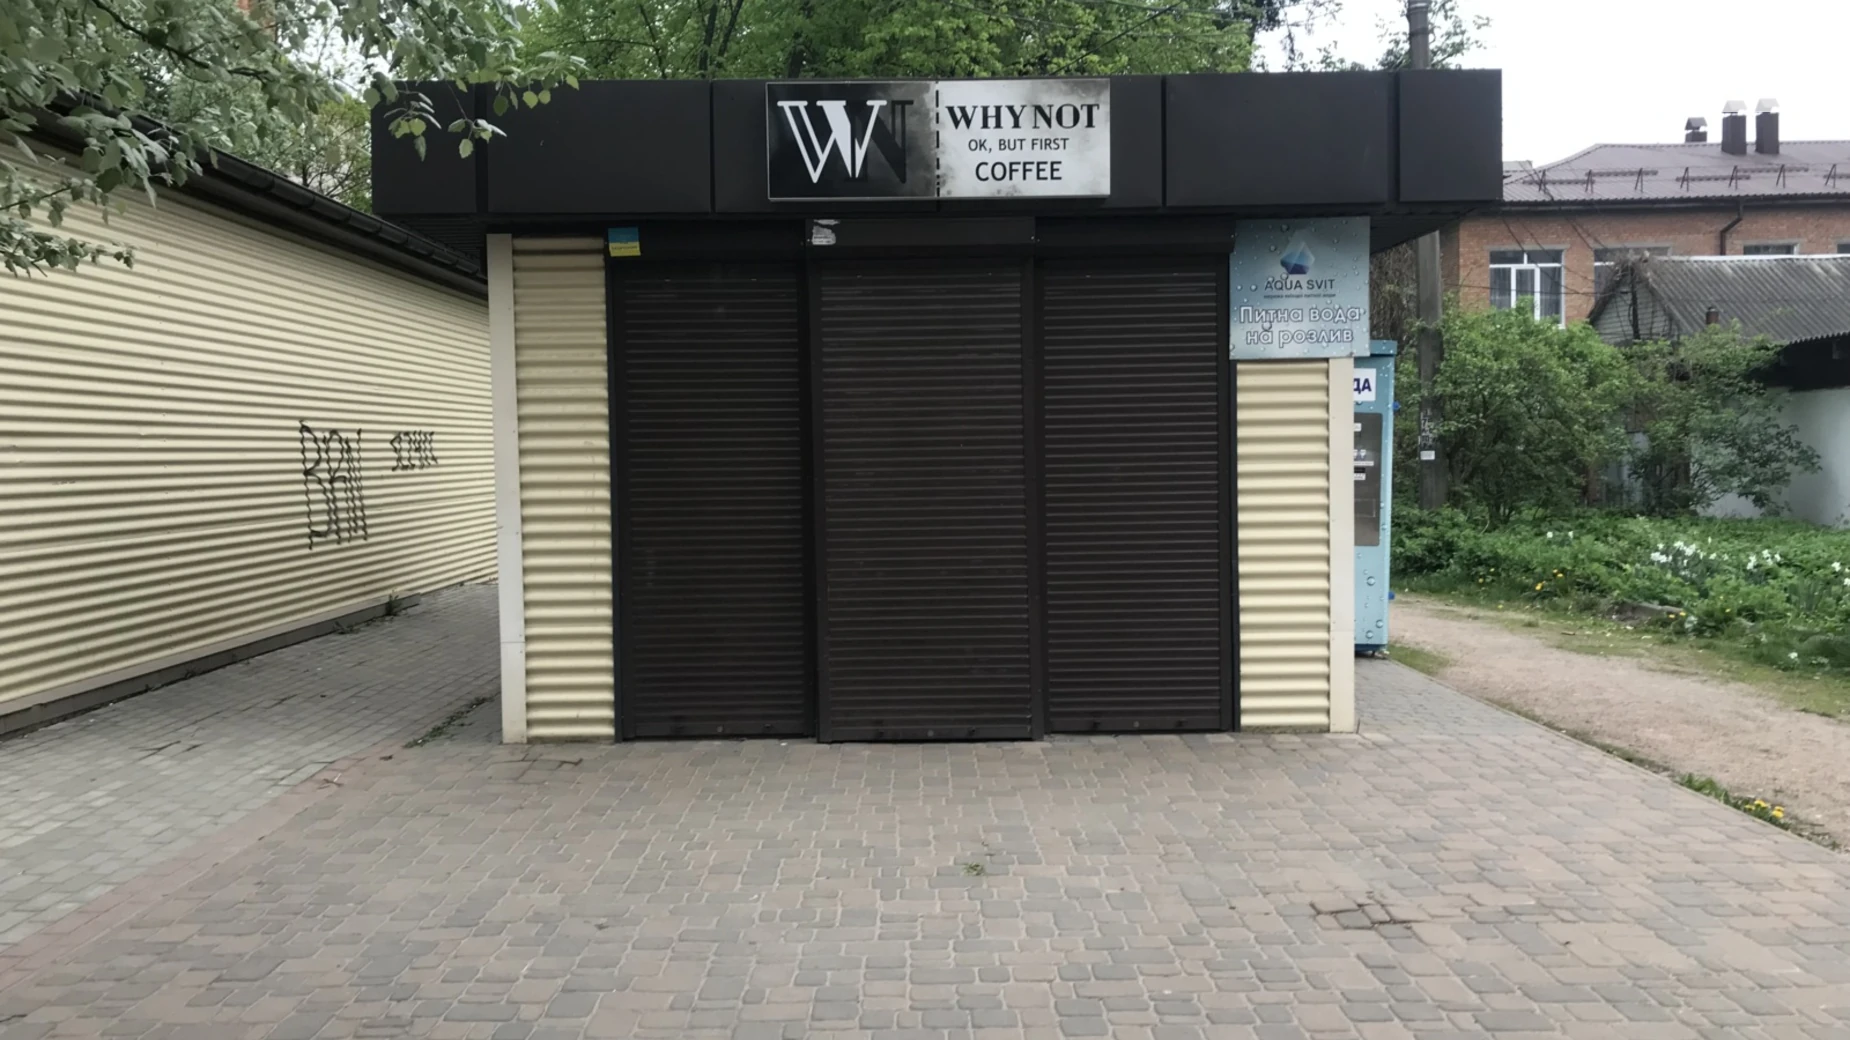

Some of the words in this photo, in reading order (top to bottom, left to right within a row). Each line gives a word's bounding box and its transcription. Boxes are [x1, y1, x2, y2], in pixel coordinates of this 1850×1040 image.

[968, 139, 992, 153] OK,
[998, 138, 1026, 151] BUT
[1031, 138, 1069, 150] FIRST
[975, 161, 1062, 182] COFFEE
[1264, 279, 1303, 291] AQUA
[1306, 278, 1335, 290] SVIT
[1239, 306, 1303, 323] Питна
[1309, 308, 1361, 323] вода
[1246, 330, 1273, 345] на
[1278, 329, 1353, 348] розлив
